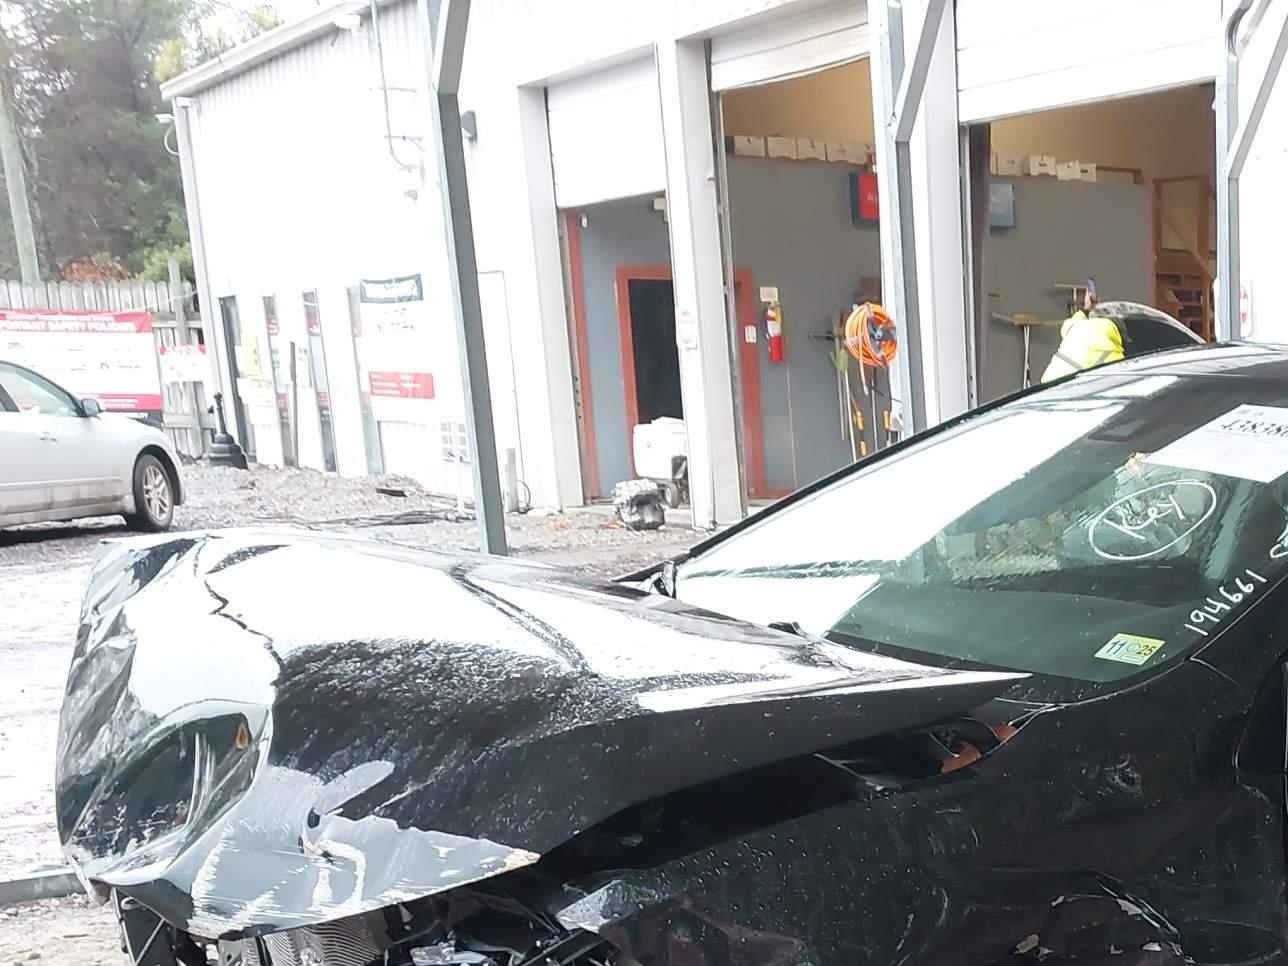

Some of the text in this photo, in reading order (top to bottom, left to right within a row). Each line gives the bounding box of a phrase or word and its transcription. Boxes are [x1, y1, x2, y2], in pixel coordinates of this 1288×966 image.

[48, 320, 86, 331] SAFETY
[1185, 569, 1268, 637] 194661
[1106, 640, 1157, 656] 11 25
